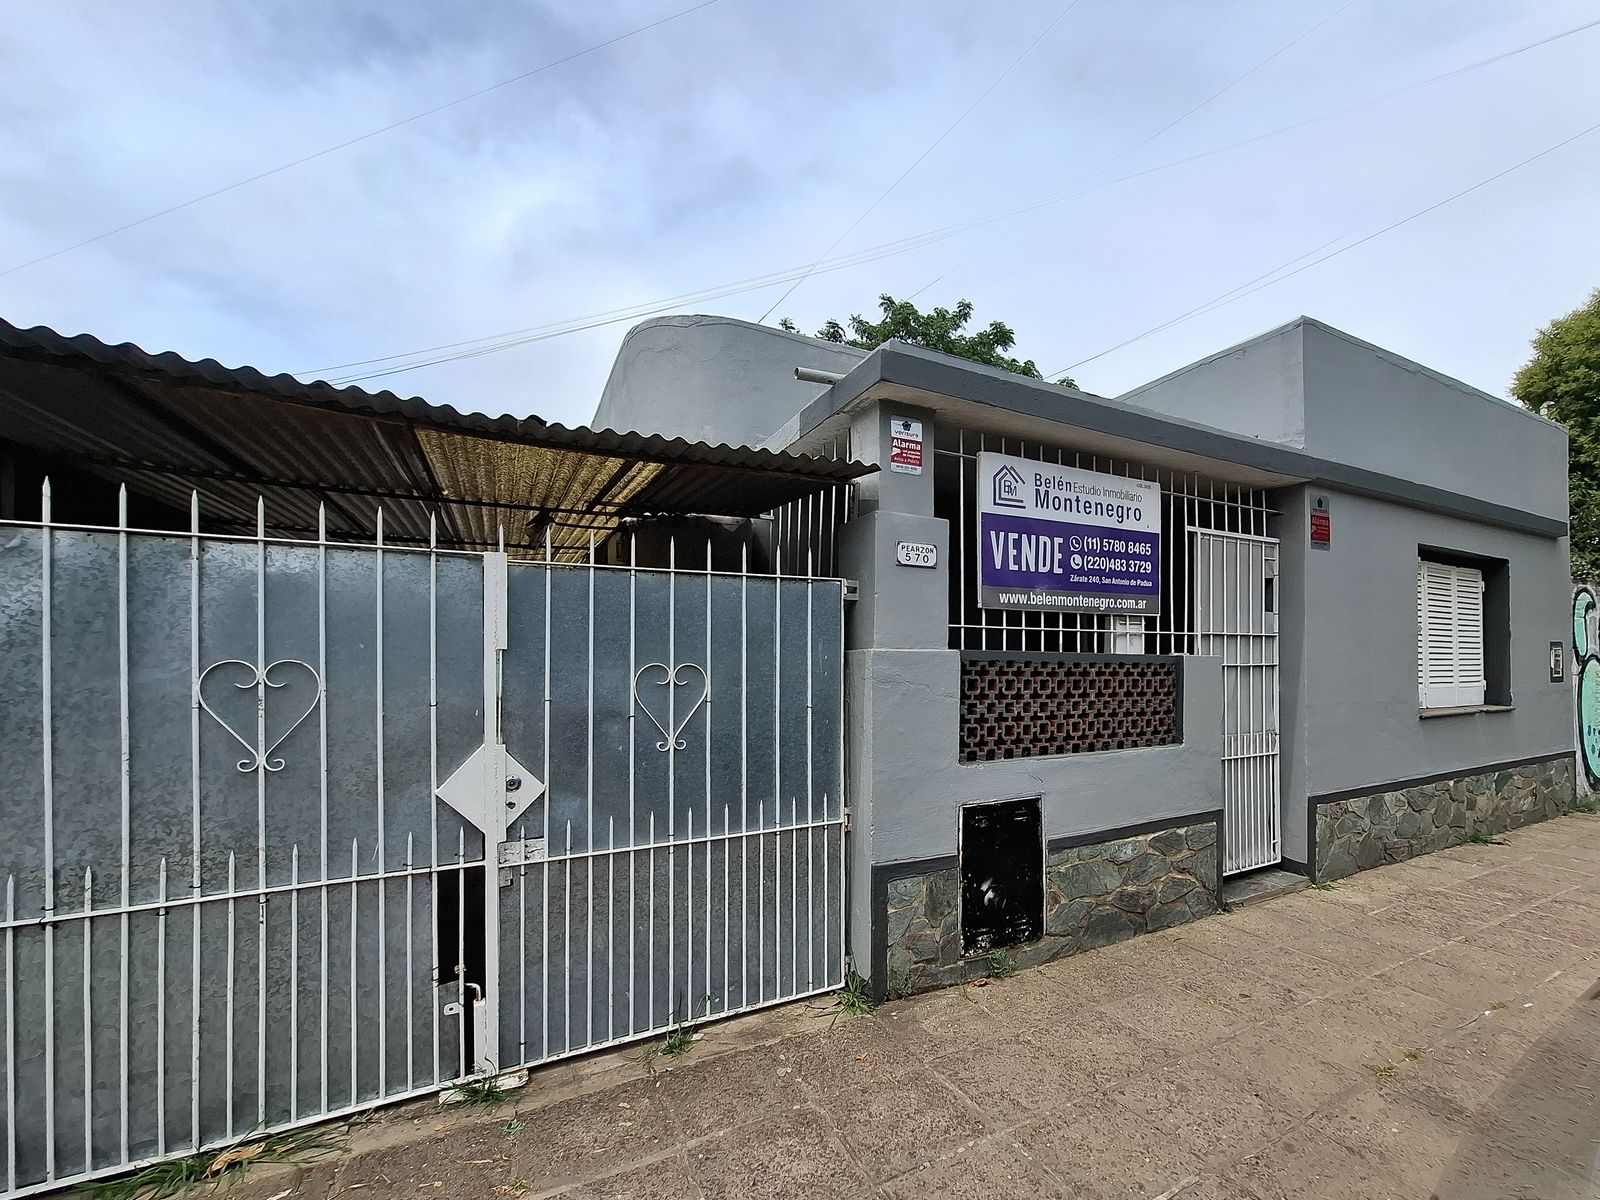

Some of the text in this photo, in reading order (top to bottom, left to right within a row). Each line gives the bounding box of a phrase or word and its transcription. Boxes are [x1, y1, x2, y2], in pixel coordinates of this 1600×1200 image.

[895, 430, 919, 438] verisure
[893, 439, 920, 451] Alarma
[1034, 472, 1072, 493] Belén
[1073, 482, 1101, 497] Estudio
[1102, 486, 1143, 503] Inmobiliario
[1034, 488, 1142, 523] Montenegro
[990, 530, 1064, 574] VENDE
[1083, 536, 1152, 556] (11) 5780 8465
[1083, 554, 1152, 574] (220)483 3729
[1070, 574, 1088, 583] Zárate
[1089, 575, 1101, 585] 240,
[1101, 576, 1111, 584] San
[1111, 578, 1129, 586] Antonio
[1137, 579, 1152, 587] Padua
[999, 591, 1147, 610] www.belenmontenegro.com.ar
